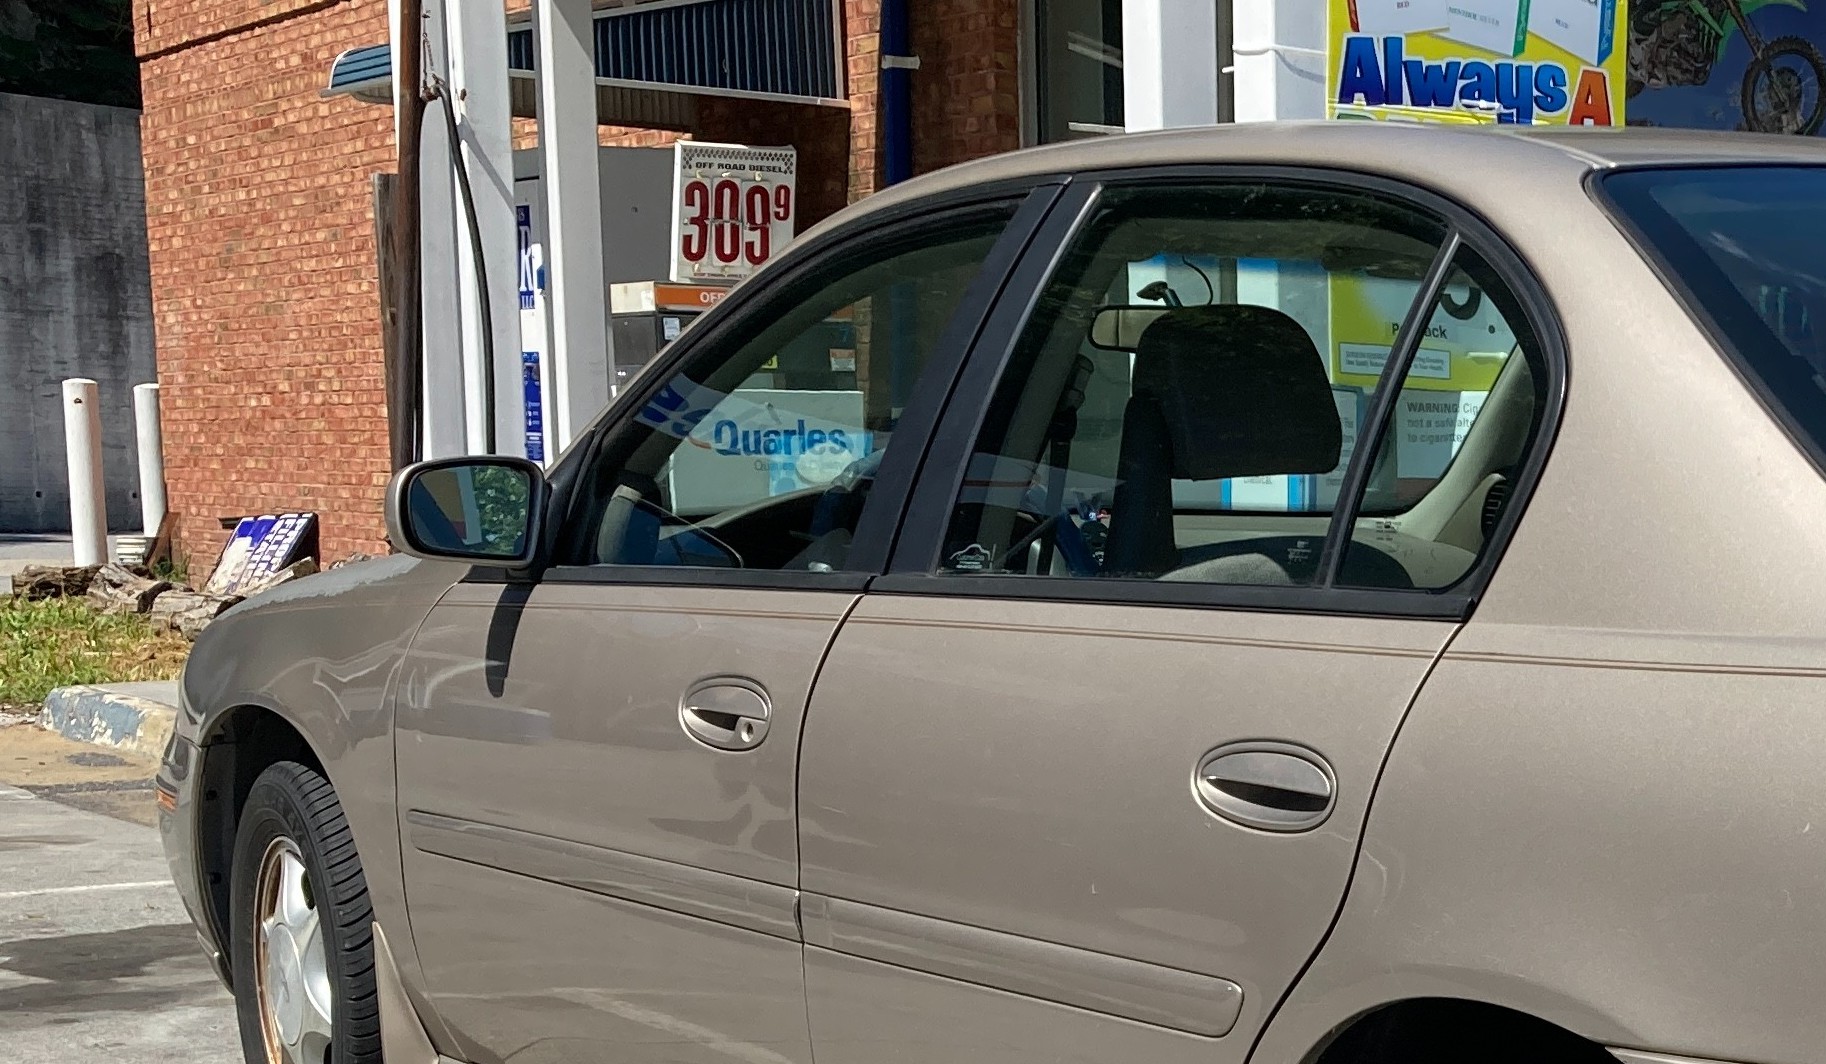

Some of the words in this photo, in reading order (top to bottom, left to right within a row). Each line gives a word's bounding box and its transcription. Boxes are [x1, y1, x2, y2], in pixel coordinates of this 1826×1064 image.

[1338, 36, 1568, 125] Always
[695, 161, 714, 170] OFF
[717, 162, 746, 171] ROAD
[749, 164, 784, 173] DIESEL
[682, 179, 771, 265] 309
[713, 418, 847, 456] Quarles
